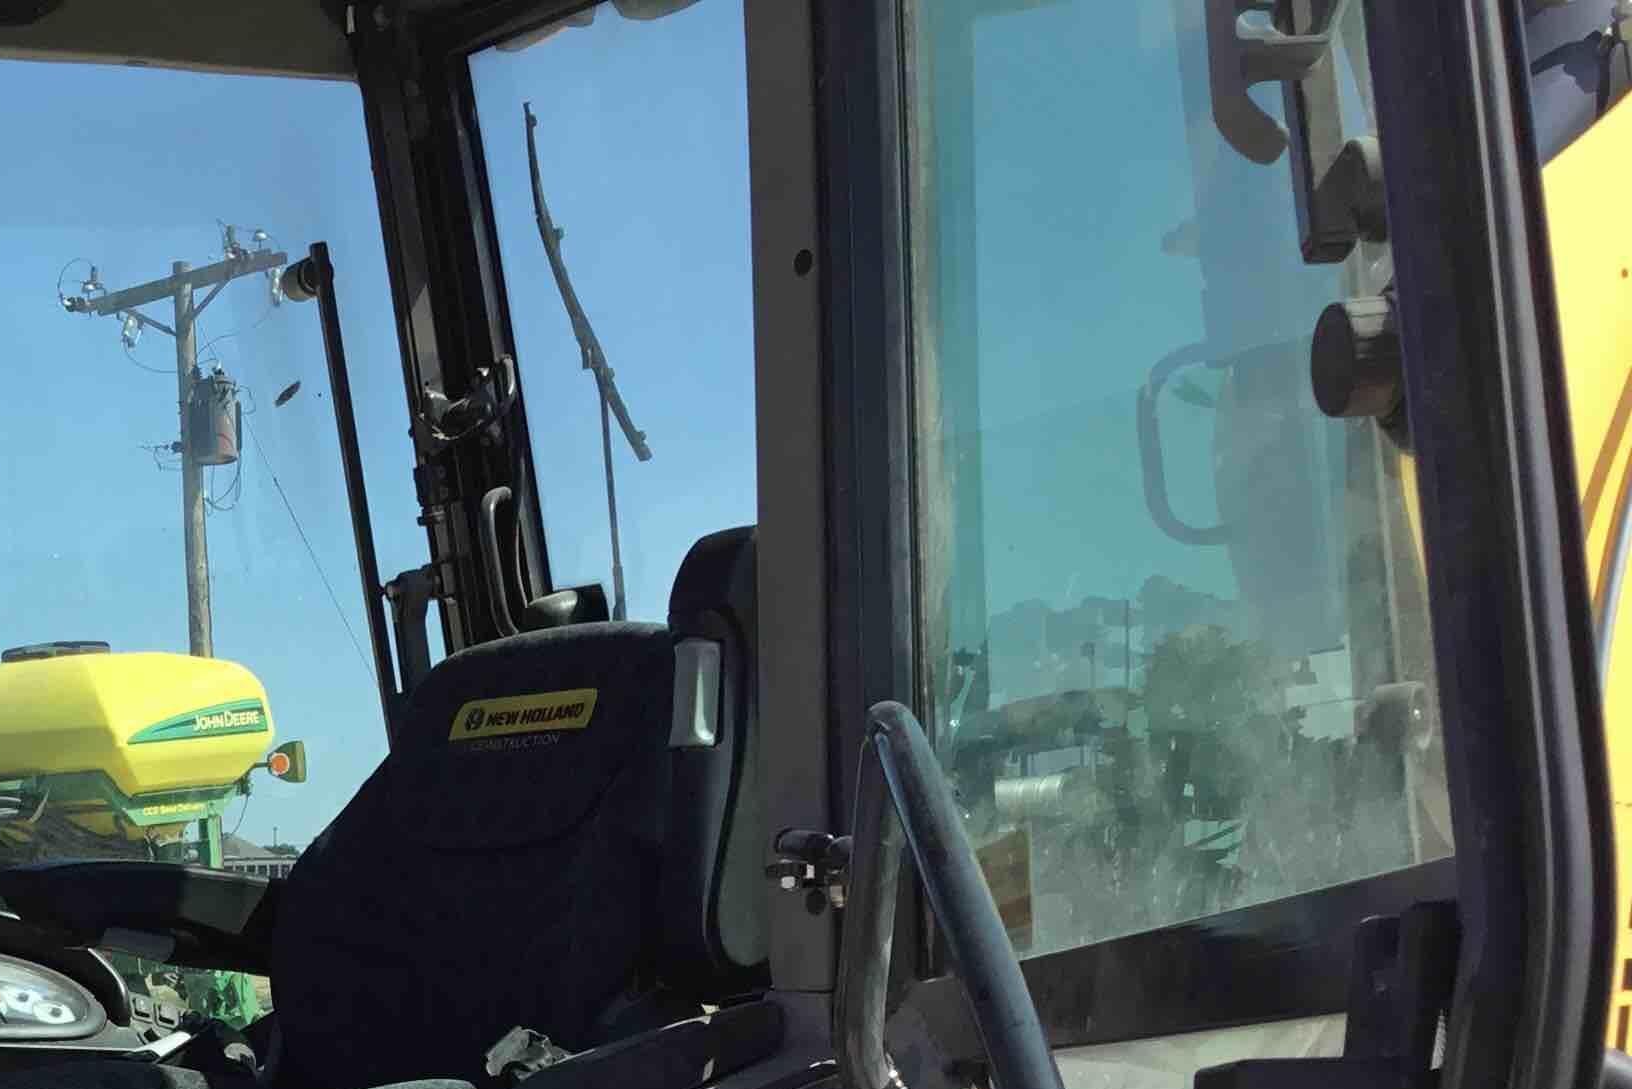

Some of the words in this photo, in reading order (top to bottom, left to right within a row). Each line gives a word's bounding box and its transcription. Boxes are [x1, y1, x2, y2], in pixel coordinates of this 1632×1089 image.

[192, 713, 225, 731] JOHN
[225, 710, 260, 727] DEERE
[485, 711, 520, 727] NEW
[521, 702, 585, 725] HOLLAND
